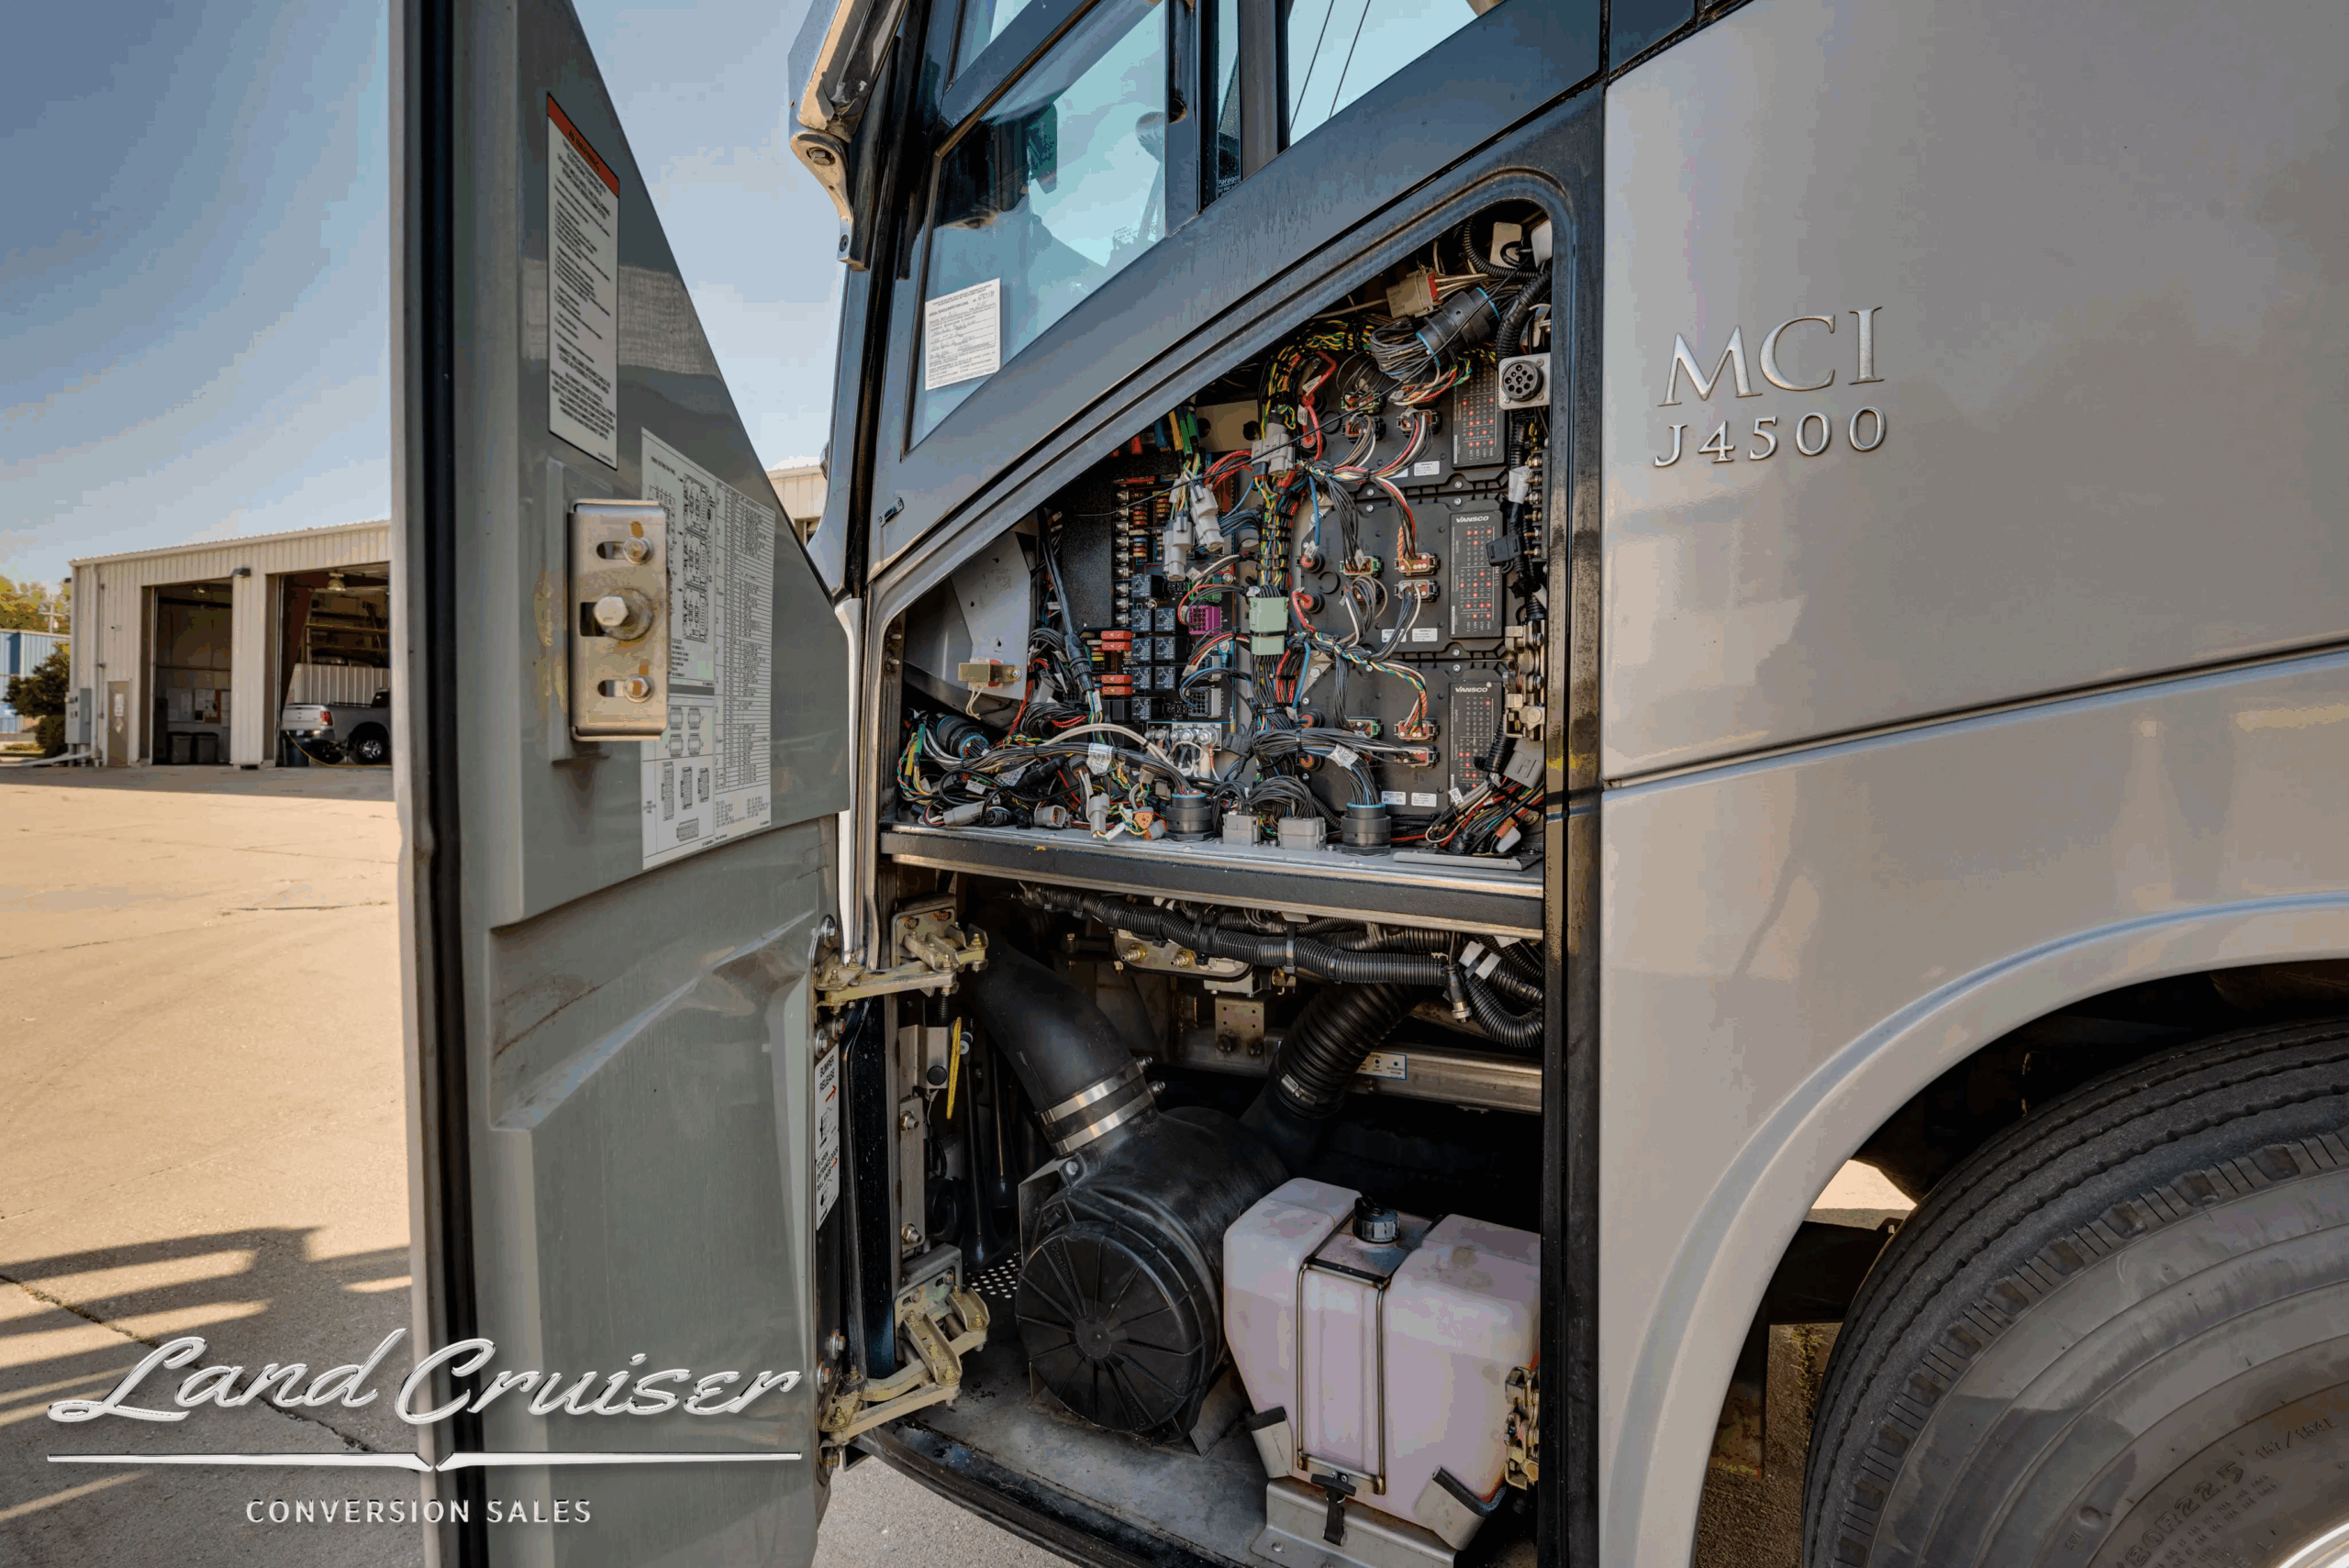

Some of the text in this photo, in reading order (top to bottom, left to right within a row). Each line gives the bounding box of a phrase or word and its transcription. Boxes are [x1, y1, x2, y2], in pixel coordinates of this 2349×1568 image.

[1657, 306, 1885, 407] MCI
[1653, 406, 1887, 468] J4500
[819, 1068, 835, 1093] RELEASE
[820, 1055, 834, 1078] BUMPER
[1051, 1242, 1072, 1284] Donaldson
